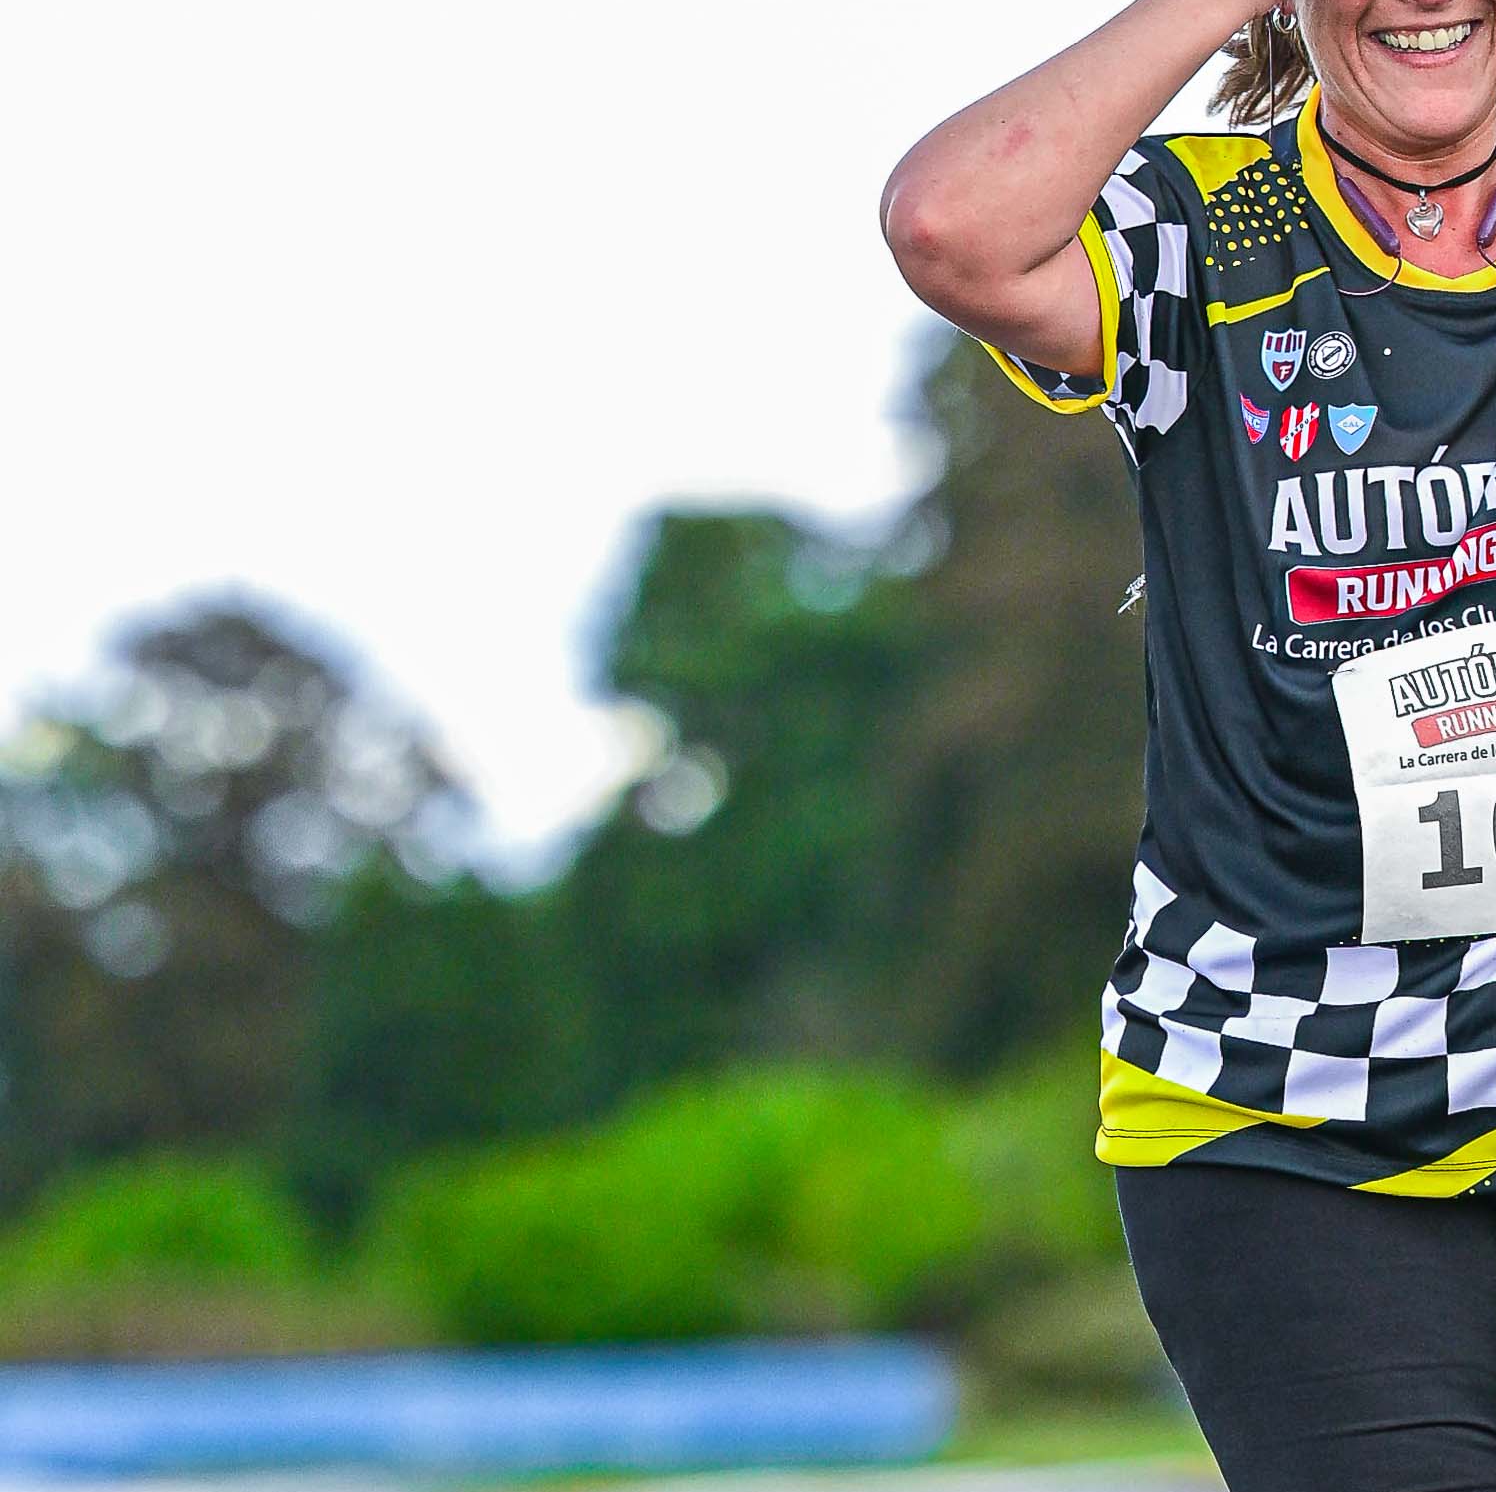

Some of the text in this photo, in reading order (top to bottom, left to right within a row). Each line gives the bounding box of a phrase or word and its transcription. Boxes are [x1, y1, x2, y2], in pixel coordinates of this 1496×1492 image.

[1252, 623, 1278, 655] La
[1285, 633, 1376, 660] Carrera
[1383, 629, 1414, 649] de
[1419, 617, 1457, 638] los
[1399, 755, 1416, 770] La
[1418, 749, 1468, 767] Carrera
[1470, 744, 1490, 761] de
